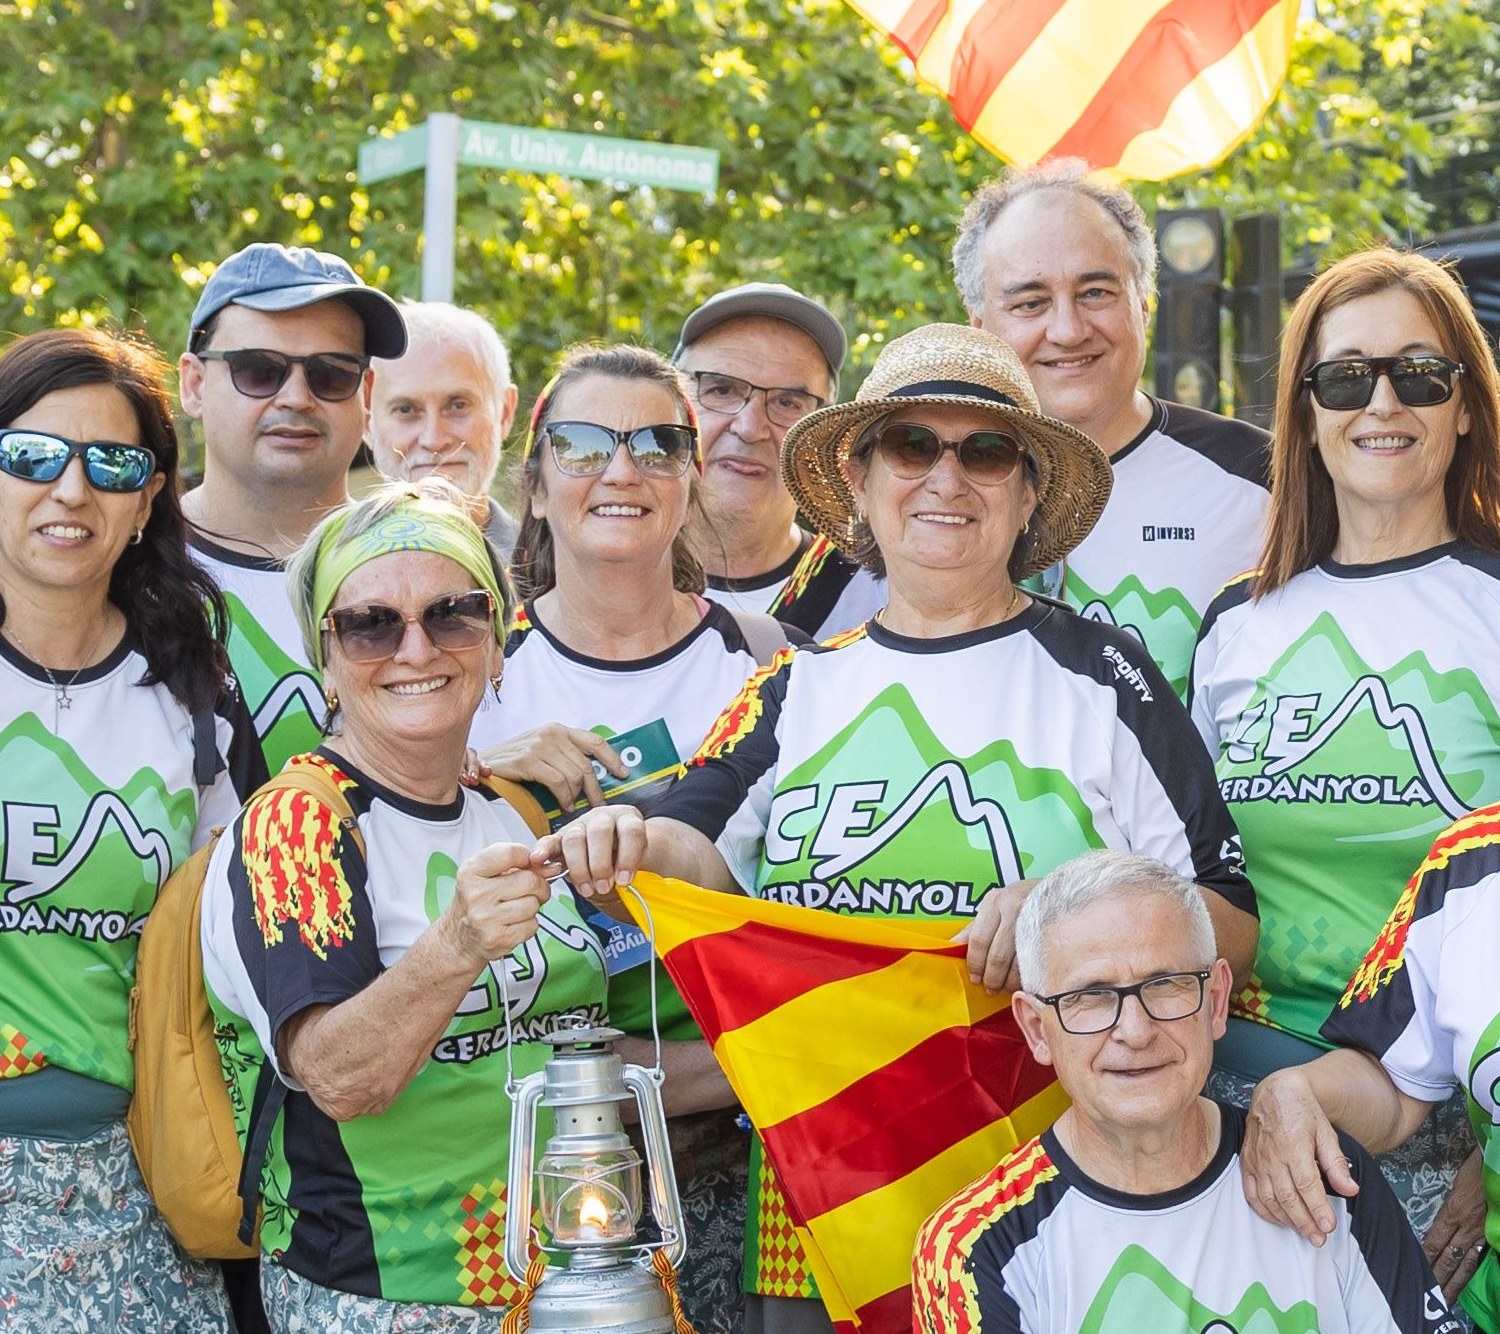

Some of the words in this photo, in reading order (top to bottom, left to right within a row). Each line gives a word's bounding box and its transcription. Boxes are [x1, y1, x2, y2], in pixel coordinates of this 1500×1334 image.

[464, 129, 503, 159] Av.
[511, 133, 573, 168] Univ.
[1102, 645, 1154, 703] SPORTY
[1218, 774, 1434, 807] ERDANYOLA
